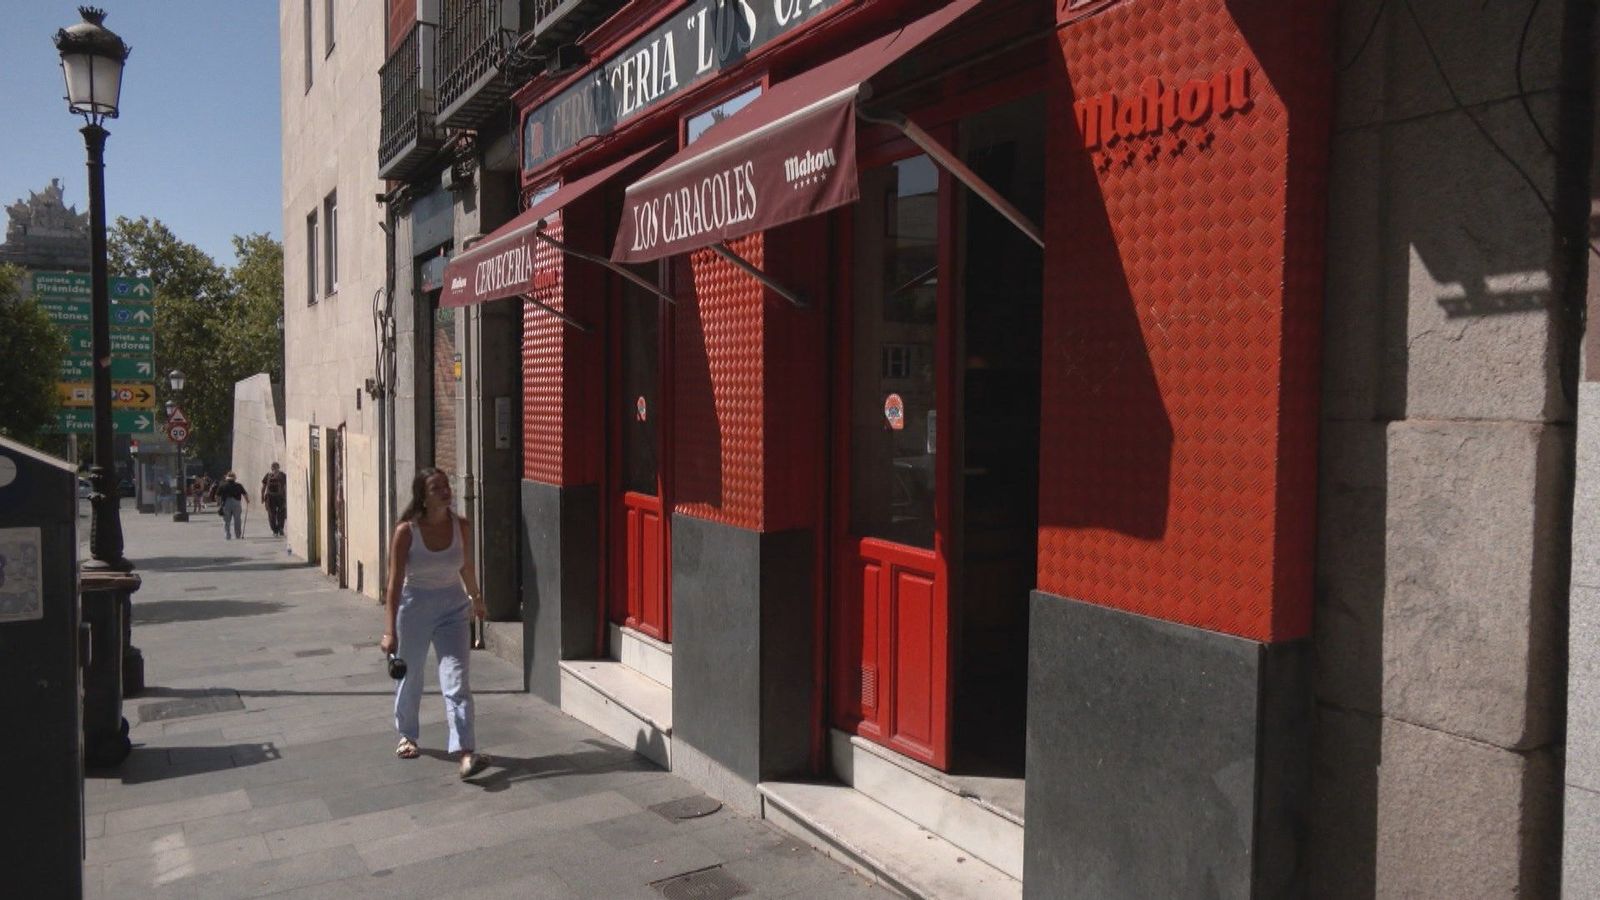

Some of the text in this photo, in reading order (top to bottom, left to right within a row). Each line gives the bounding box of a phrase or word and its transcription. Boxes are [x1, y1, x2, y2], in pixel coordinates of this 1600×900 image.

[1073, 67, 1249, 148] Mahou
[631, 148, 837, 251] LOS CARACOLES Mahou
